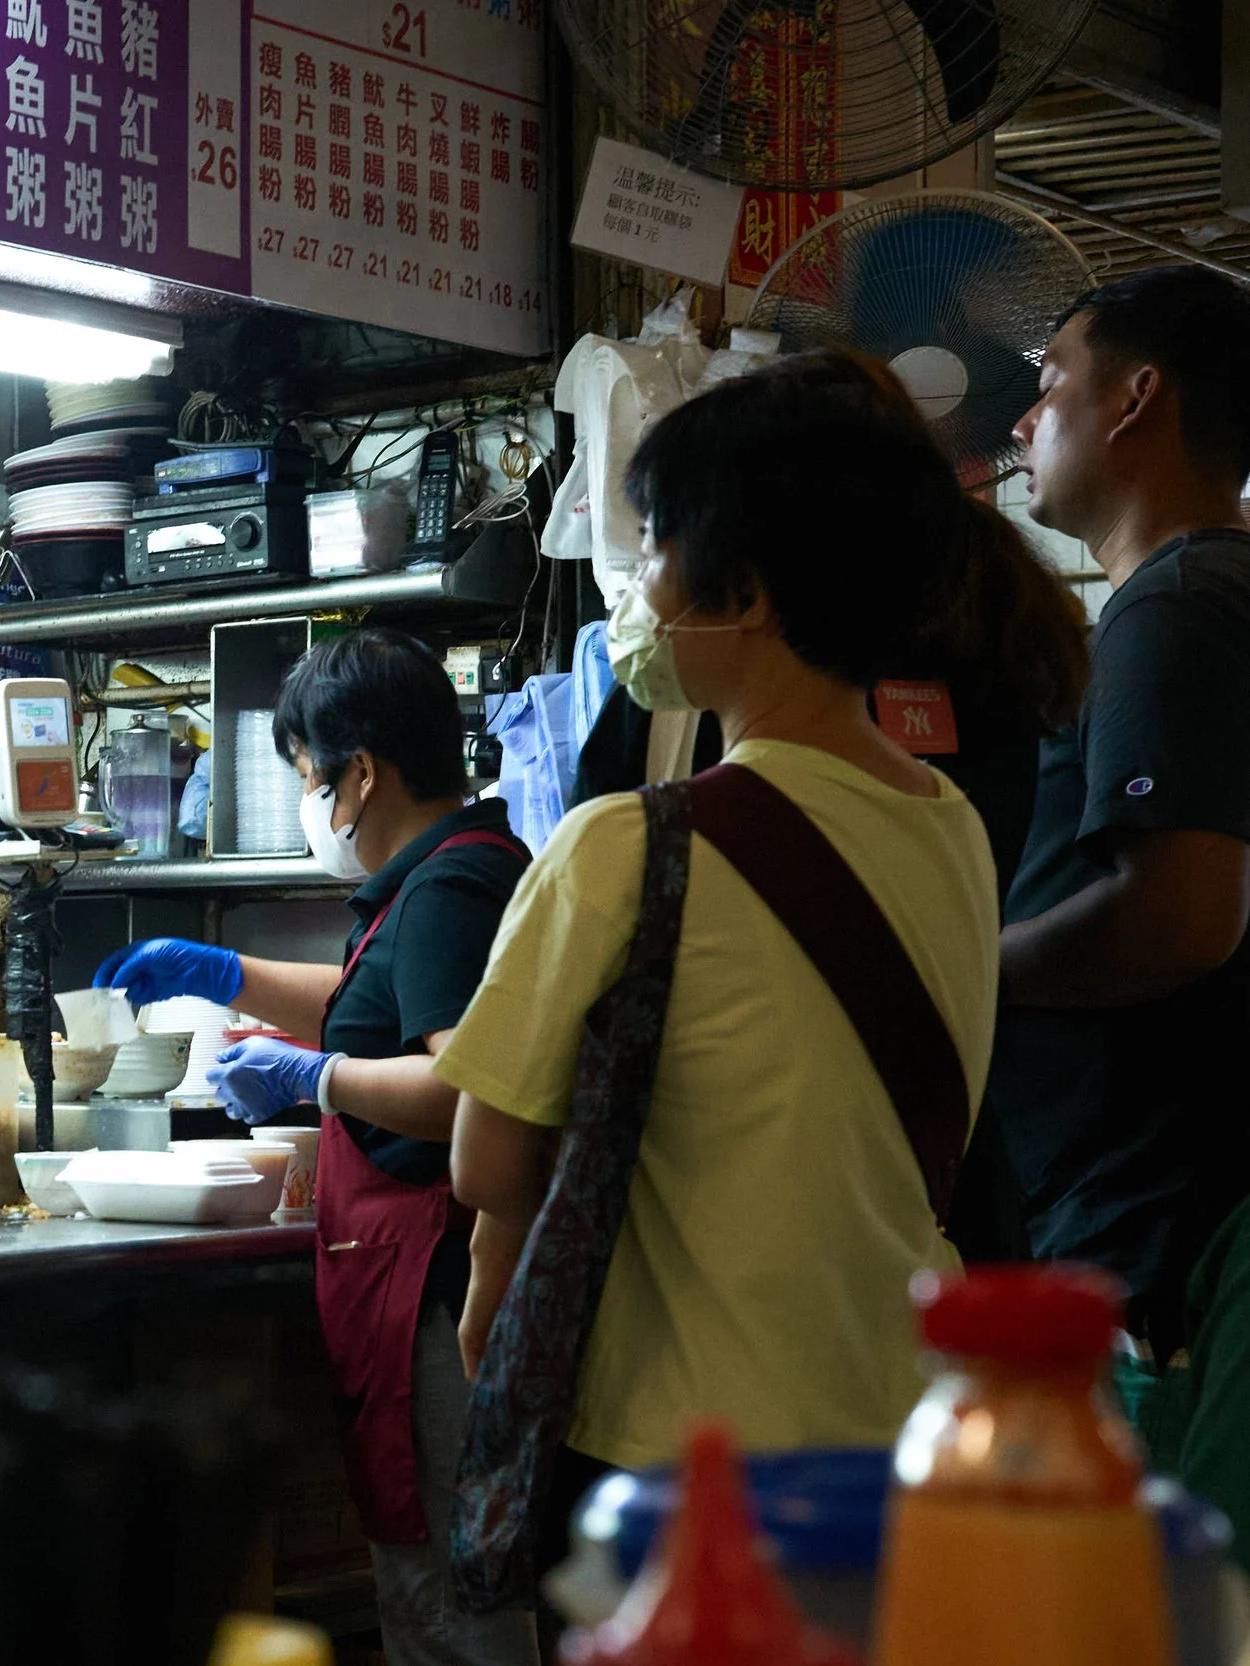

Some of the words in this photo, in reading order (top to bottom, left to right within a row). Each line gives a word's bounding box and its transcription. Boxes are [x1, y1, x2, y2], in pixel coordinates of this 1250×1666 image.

[382, 2, 427, 58] $21
[64, 0, 104, 241] 魚片粥
[120, 0, 160, 255] 豬紅粥
[195, 91, 235, 133] 外賣
[259, 41, 283, 203] 瘦肉腸粉
[294, 52, 317, 212] 魚片腸粉
[362, 71, 386, 228] 魷魚腸粉
[396, 83, 419, 237] 牛肉腸粉
[429, 92, 450, 245] 叉燒腸粉
[520, 119, 540, 193] 腸粉
[634, 223, 642, 236] 1
[883, 686, 941, 701] YANKEES
